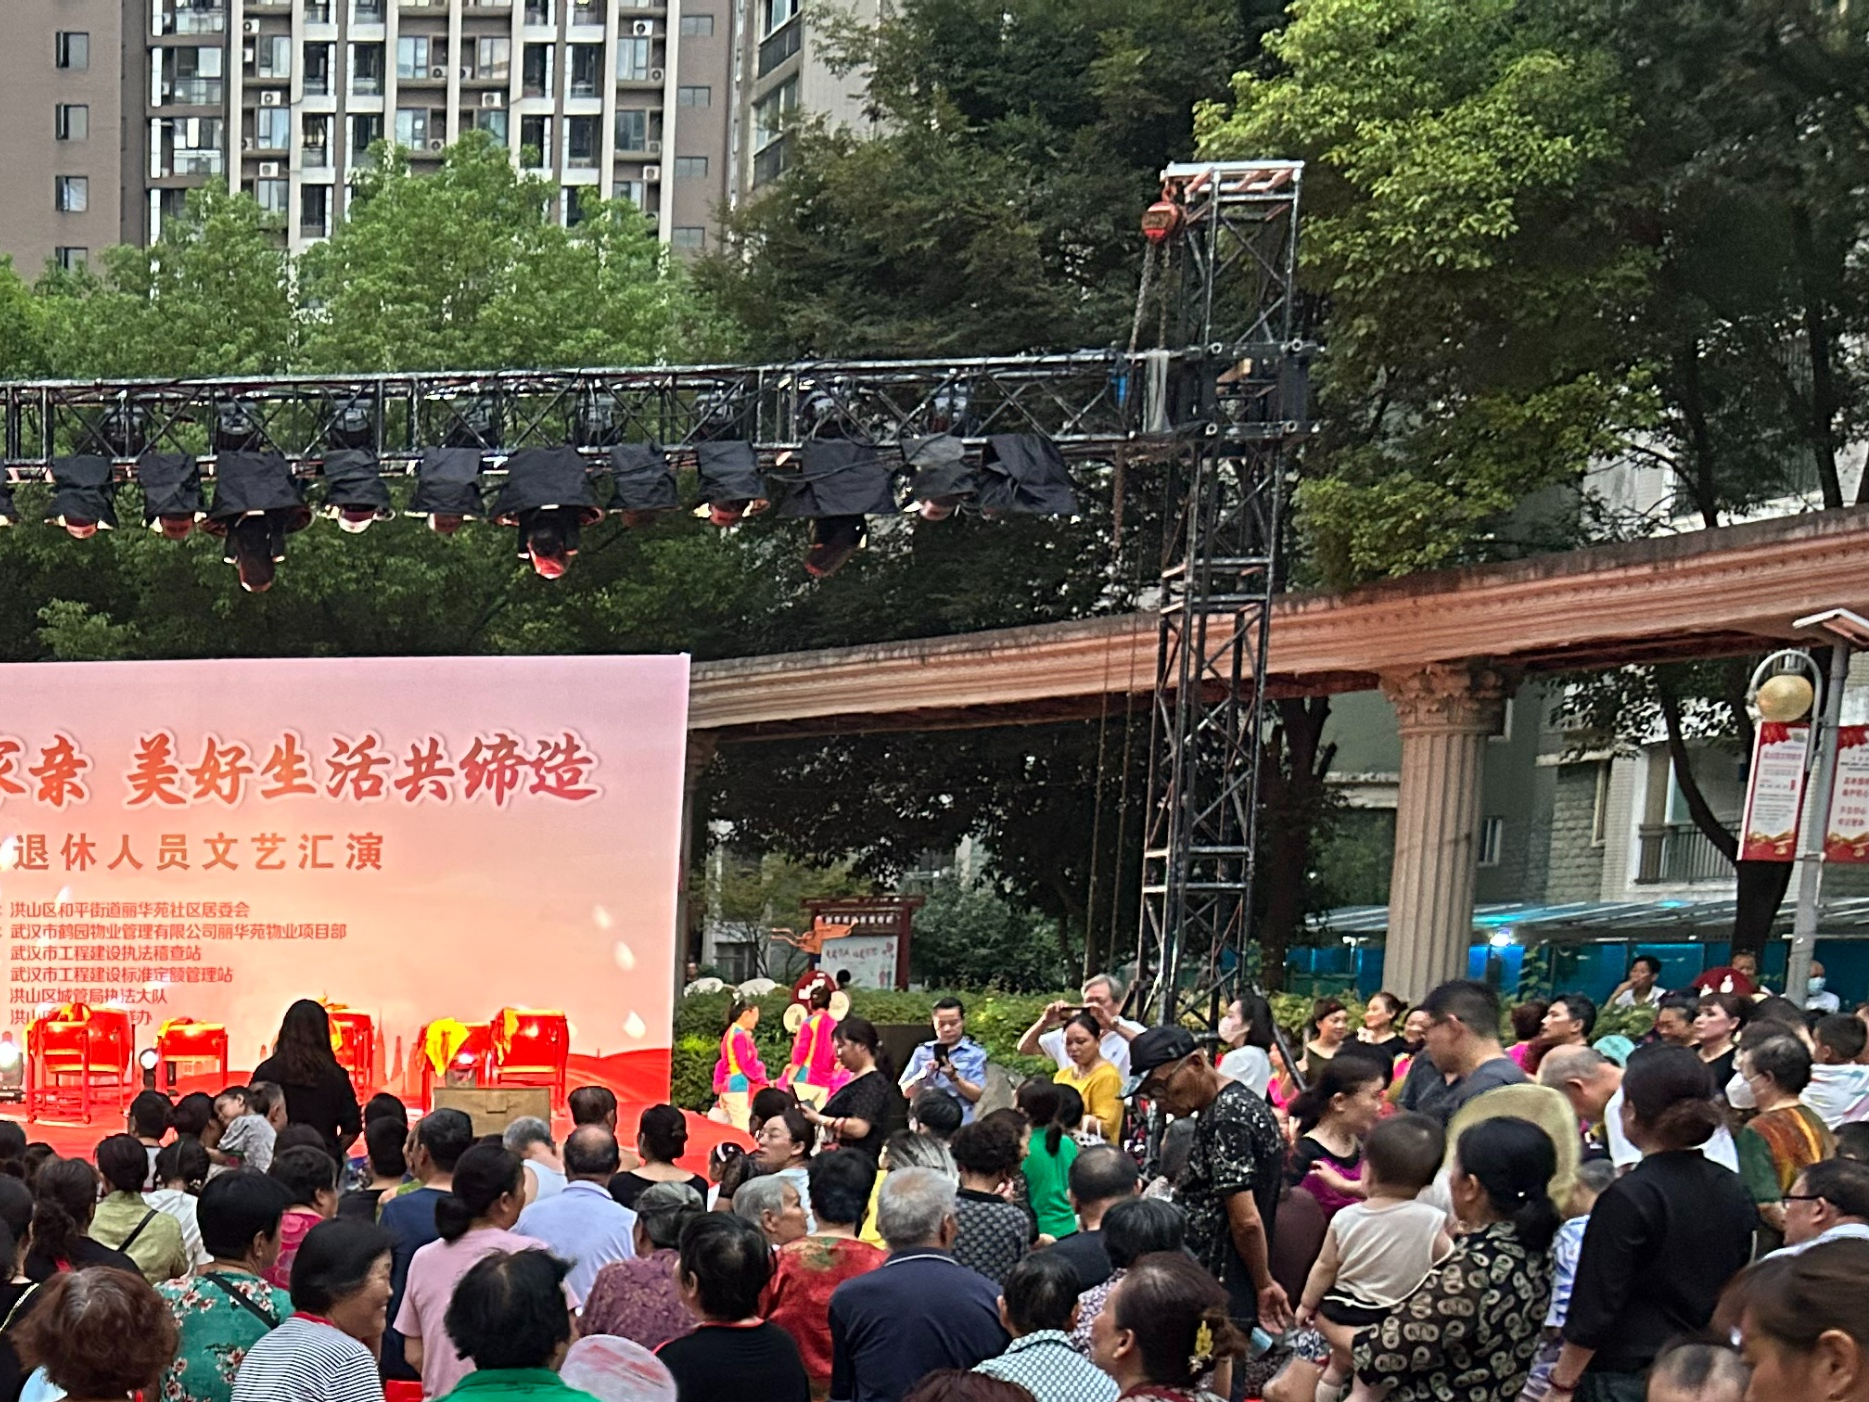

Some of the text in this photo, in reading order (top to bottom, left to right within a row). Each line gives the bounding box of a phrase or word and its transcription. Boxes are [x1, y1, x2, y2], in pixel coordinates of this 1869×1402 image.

[126, 731, 600, 808] 美好生活共缔造
